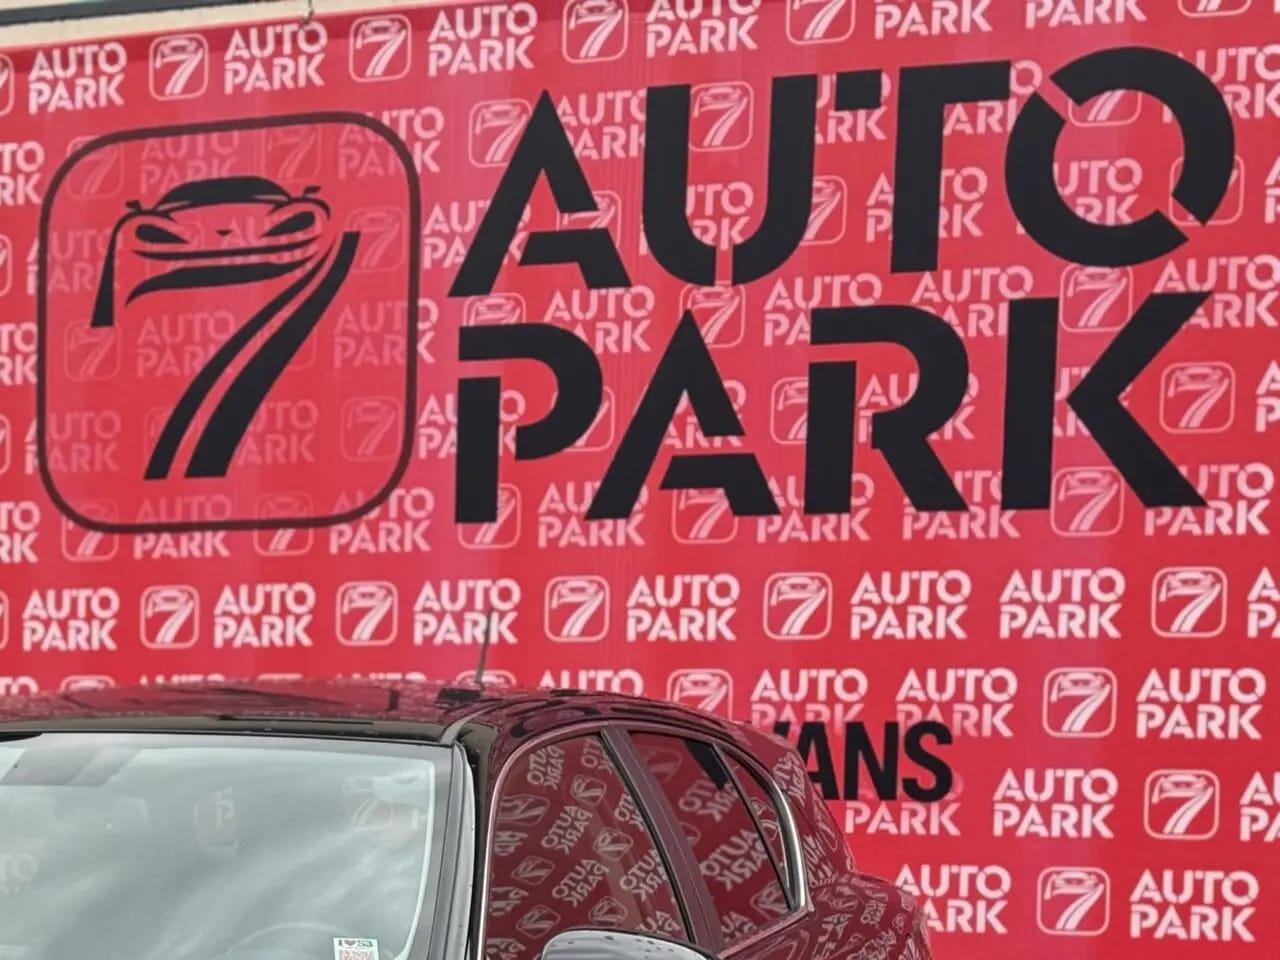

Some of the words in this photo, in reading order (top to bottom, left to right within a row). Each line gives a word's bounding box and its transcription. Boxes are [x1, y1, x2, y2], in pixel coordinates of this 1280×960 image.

[427, 12, 537, 43] AUTO
[646, 14, 759, 59] PARK
[874, 0, 993, 40] PARK
[27, 41, 127, 82] AUTO
[224, 27, 328, 63] AUTO
[427, 34, 535, 80] PARK
[224, 52, 326, 95] PARK
[28, 72, 125, 115] PARK
[448, 45, 1236, 299] AUTO
[1053, 158, 1143, 196] UTO
[764, 273, 882, 311] AUTO
[910, 265, 1034, 305] AUTO
[542, 284, 655, 324] AUTO
[454, 289, 1215, 523] PARK
[238, 433, 316, 464] ARK
[538, 512, 645, 548] PARK
[757, 507, 870, 543] PARK
[903, 504, 1020, 539] PARK
[1145, 498, 1270, 536] PARK
[330, 519, 431, 554] PARK
[213, 582, 316, 617] AUTO
[413, 578, 521, 616] AUTO
[626, 573, 740, 608] AUTO
[850, 570, 972, 606] AUTO
[999, 567, 1125, 604] AUTO
[22, 587, 120, 622] AUTO
[850, 604, 968, 640] PARK
[1000, 602, 1122, 639] PARK
[22, 618, 117, 652] PARK
[214, 613, 313, 648] PARK
[413, 612, 518, 649] PARK
[626, 607, 736, 642] PARK
[750, 668, 868, 702] AUTO
[896, 667, 1018, 703] AUTO
[1136, 667, 1266, 705] AUTO
[1136, 703, 1262, 740] PARK
[773, 720, 953, 802] ANS
[993, 768, 1118, 804] AUTO
[845, 801, 962, 836] PARK
[993, 802, 1114, 839] PARK
[1130, 869, 1259, 906] AUTO
[925, 899, 1010, 935] ARK
[1130, 902, 1255, 942] PARK
